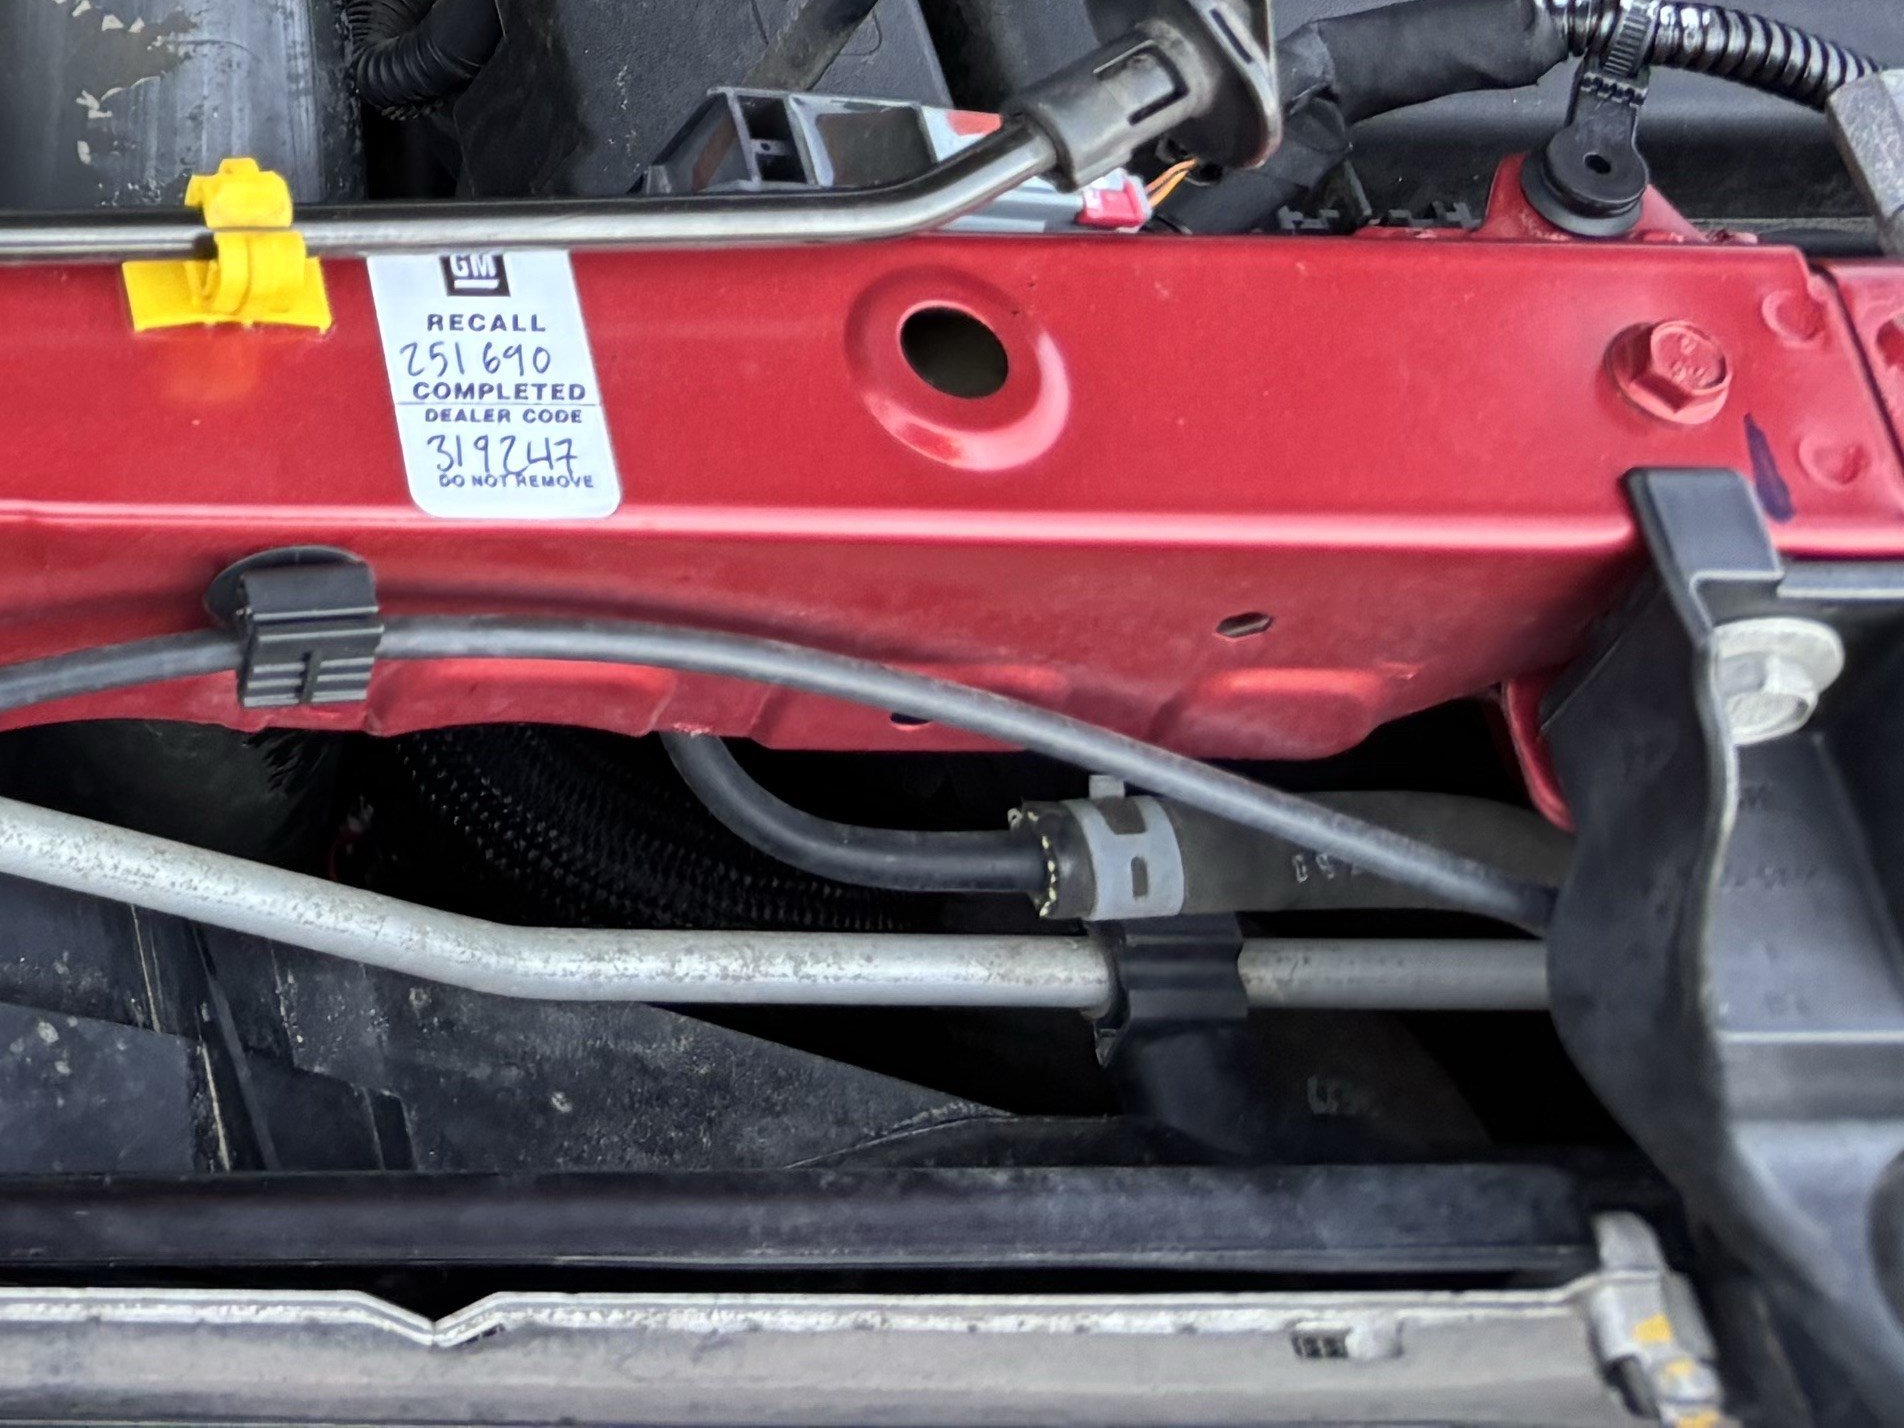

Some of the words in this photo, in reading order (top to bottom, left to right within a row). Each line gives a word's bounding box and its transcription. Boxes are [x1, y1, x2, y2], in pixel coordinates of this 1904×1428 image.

[450, 253, 497, 277] GM
[427, 313, 546, 332] RECALL
[412, 382, 586, 401] COMPLETED
[425, 408, 511, 424] DEALER
[522, 408, 582, 424] CODE
[439, 474, 465, 488] DO
[472, 474, 508, 488] NOT
[516, 474, 594, 489] REMOVE
